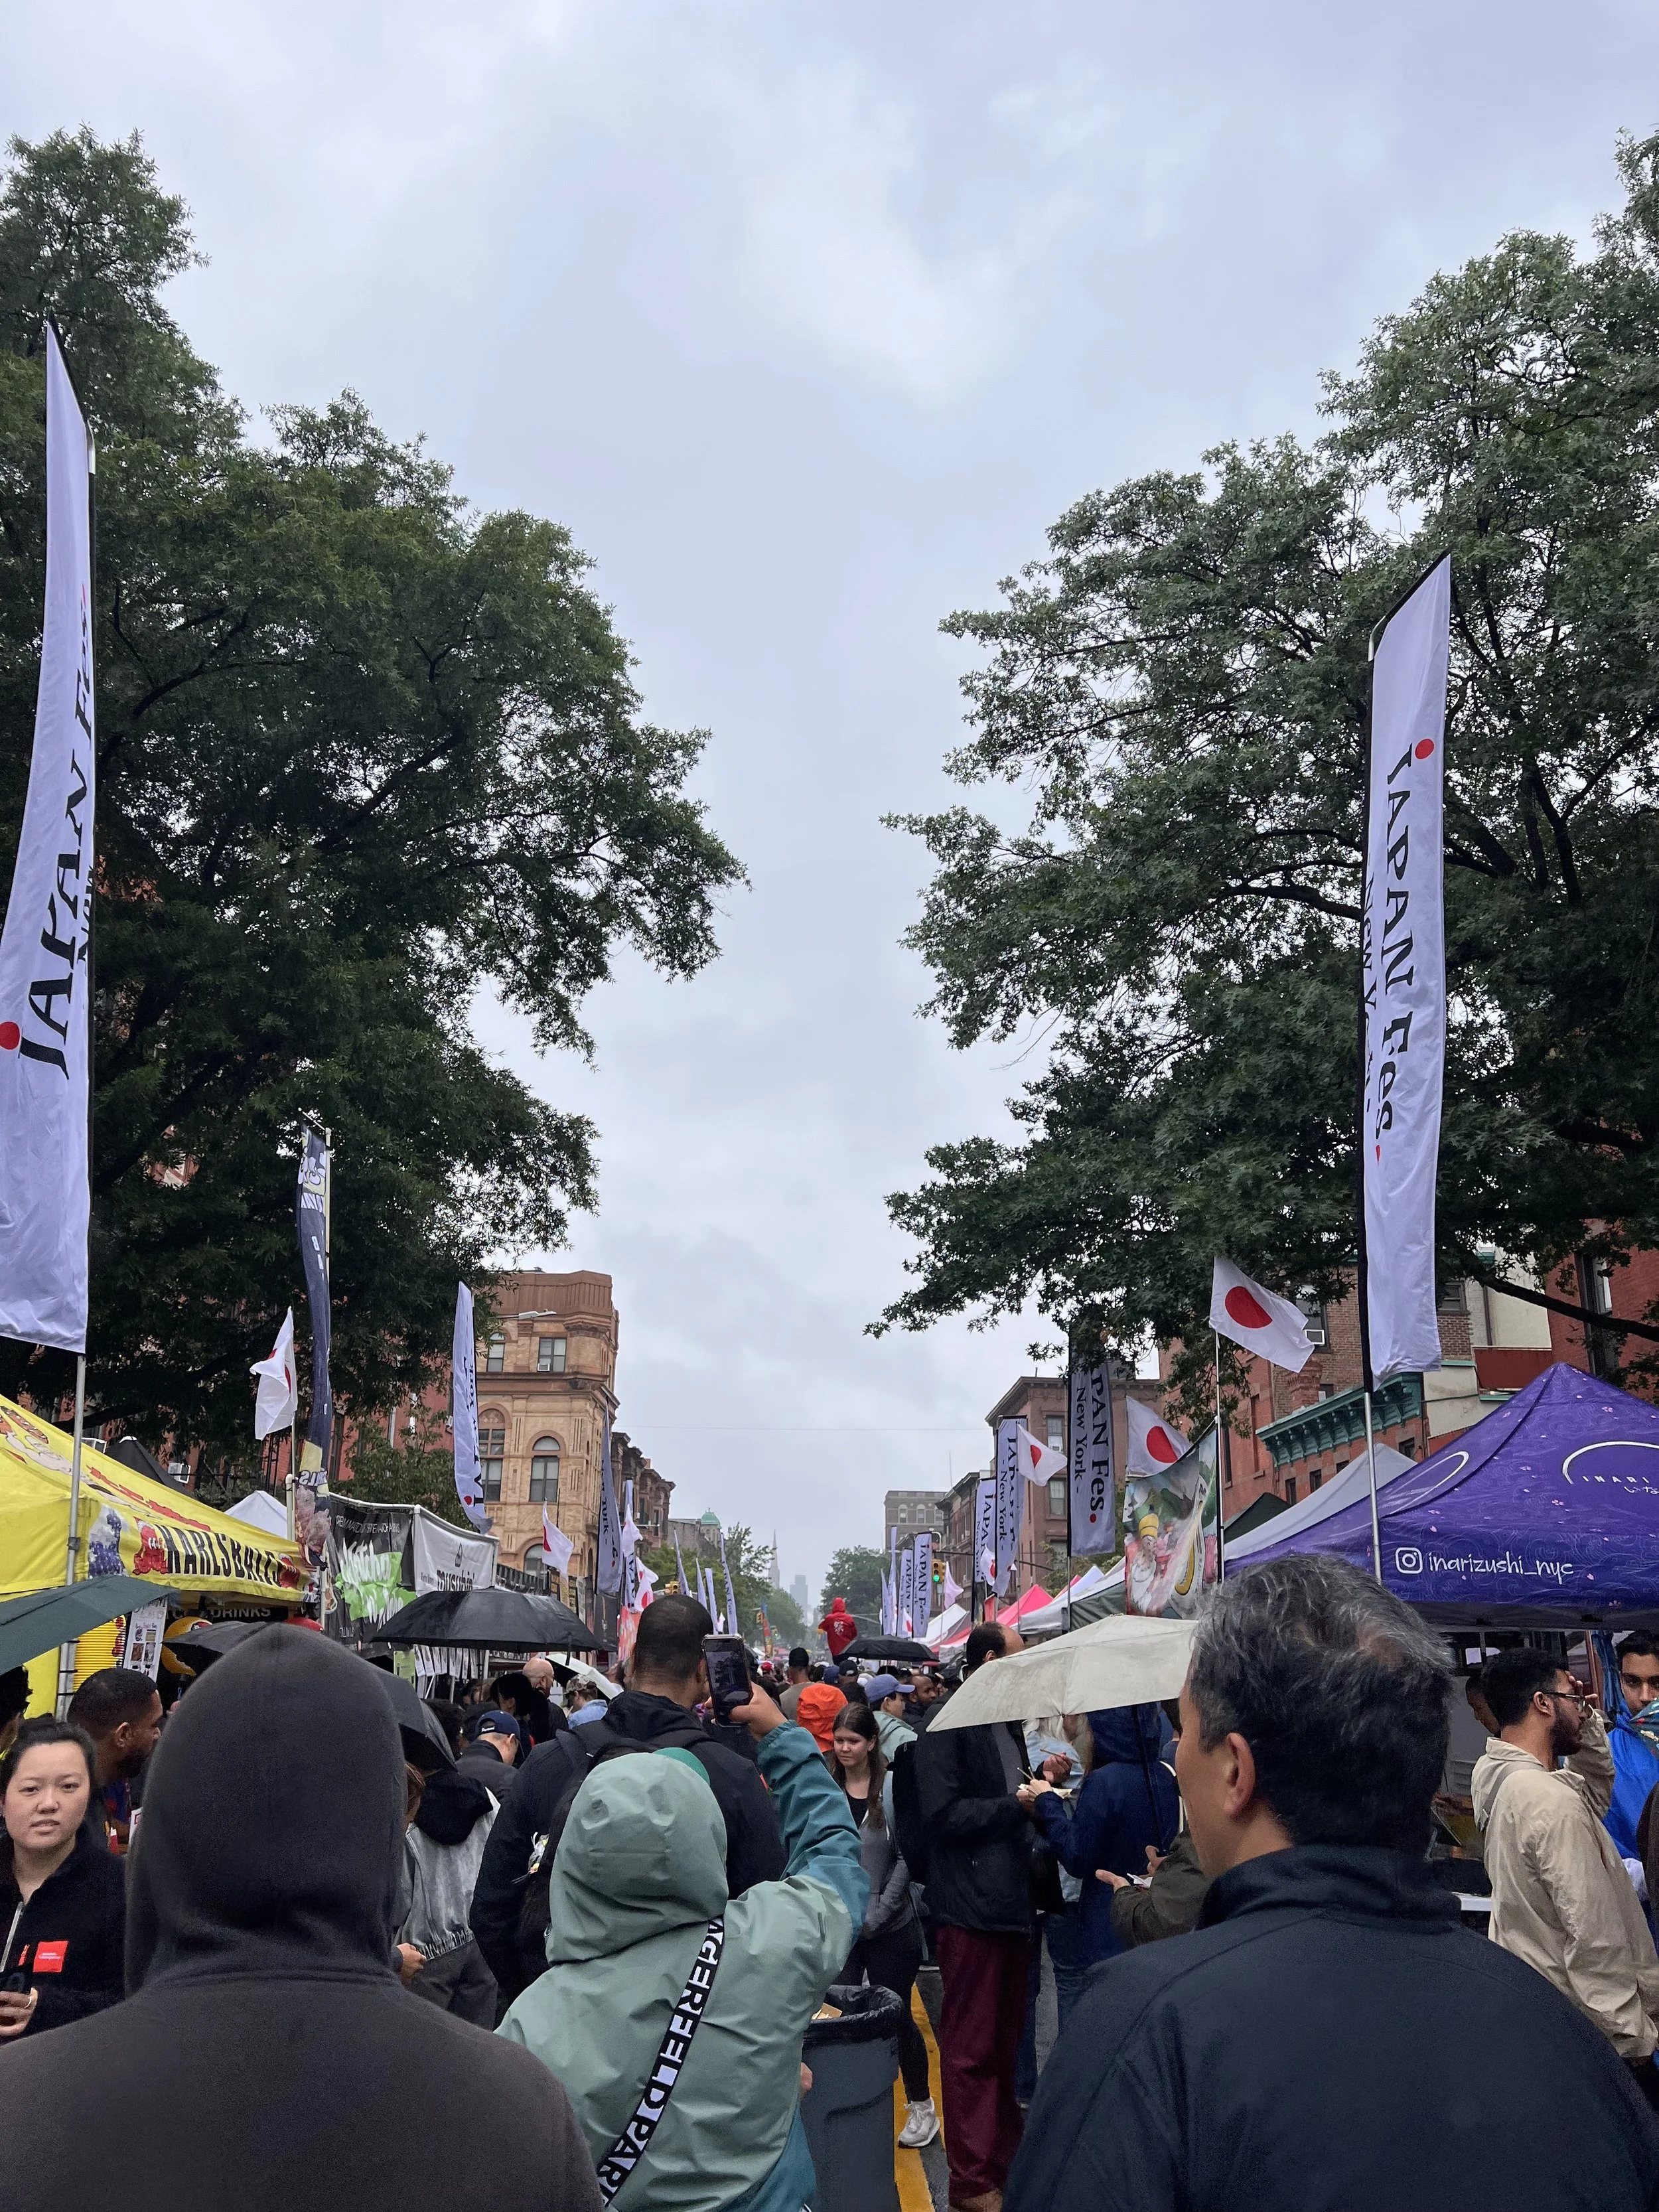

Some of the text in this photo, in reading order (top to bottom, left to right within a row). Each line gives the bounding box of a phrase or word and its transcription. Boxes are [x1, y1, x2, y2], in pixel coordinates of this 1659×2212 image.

[1381, 743, 1413, 994] JAPAN
[1074, 1386, 1088, 1481] New York
[999, 1509, 1007, 1542] York
[918, 1545, 927, 1592] JAPAN
[1429, 1551, 1574, 1585] inarizushi_nyc
